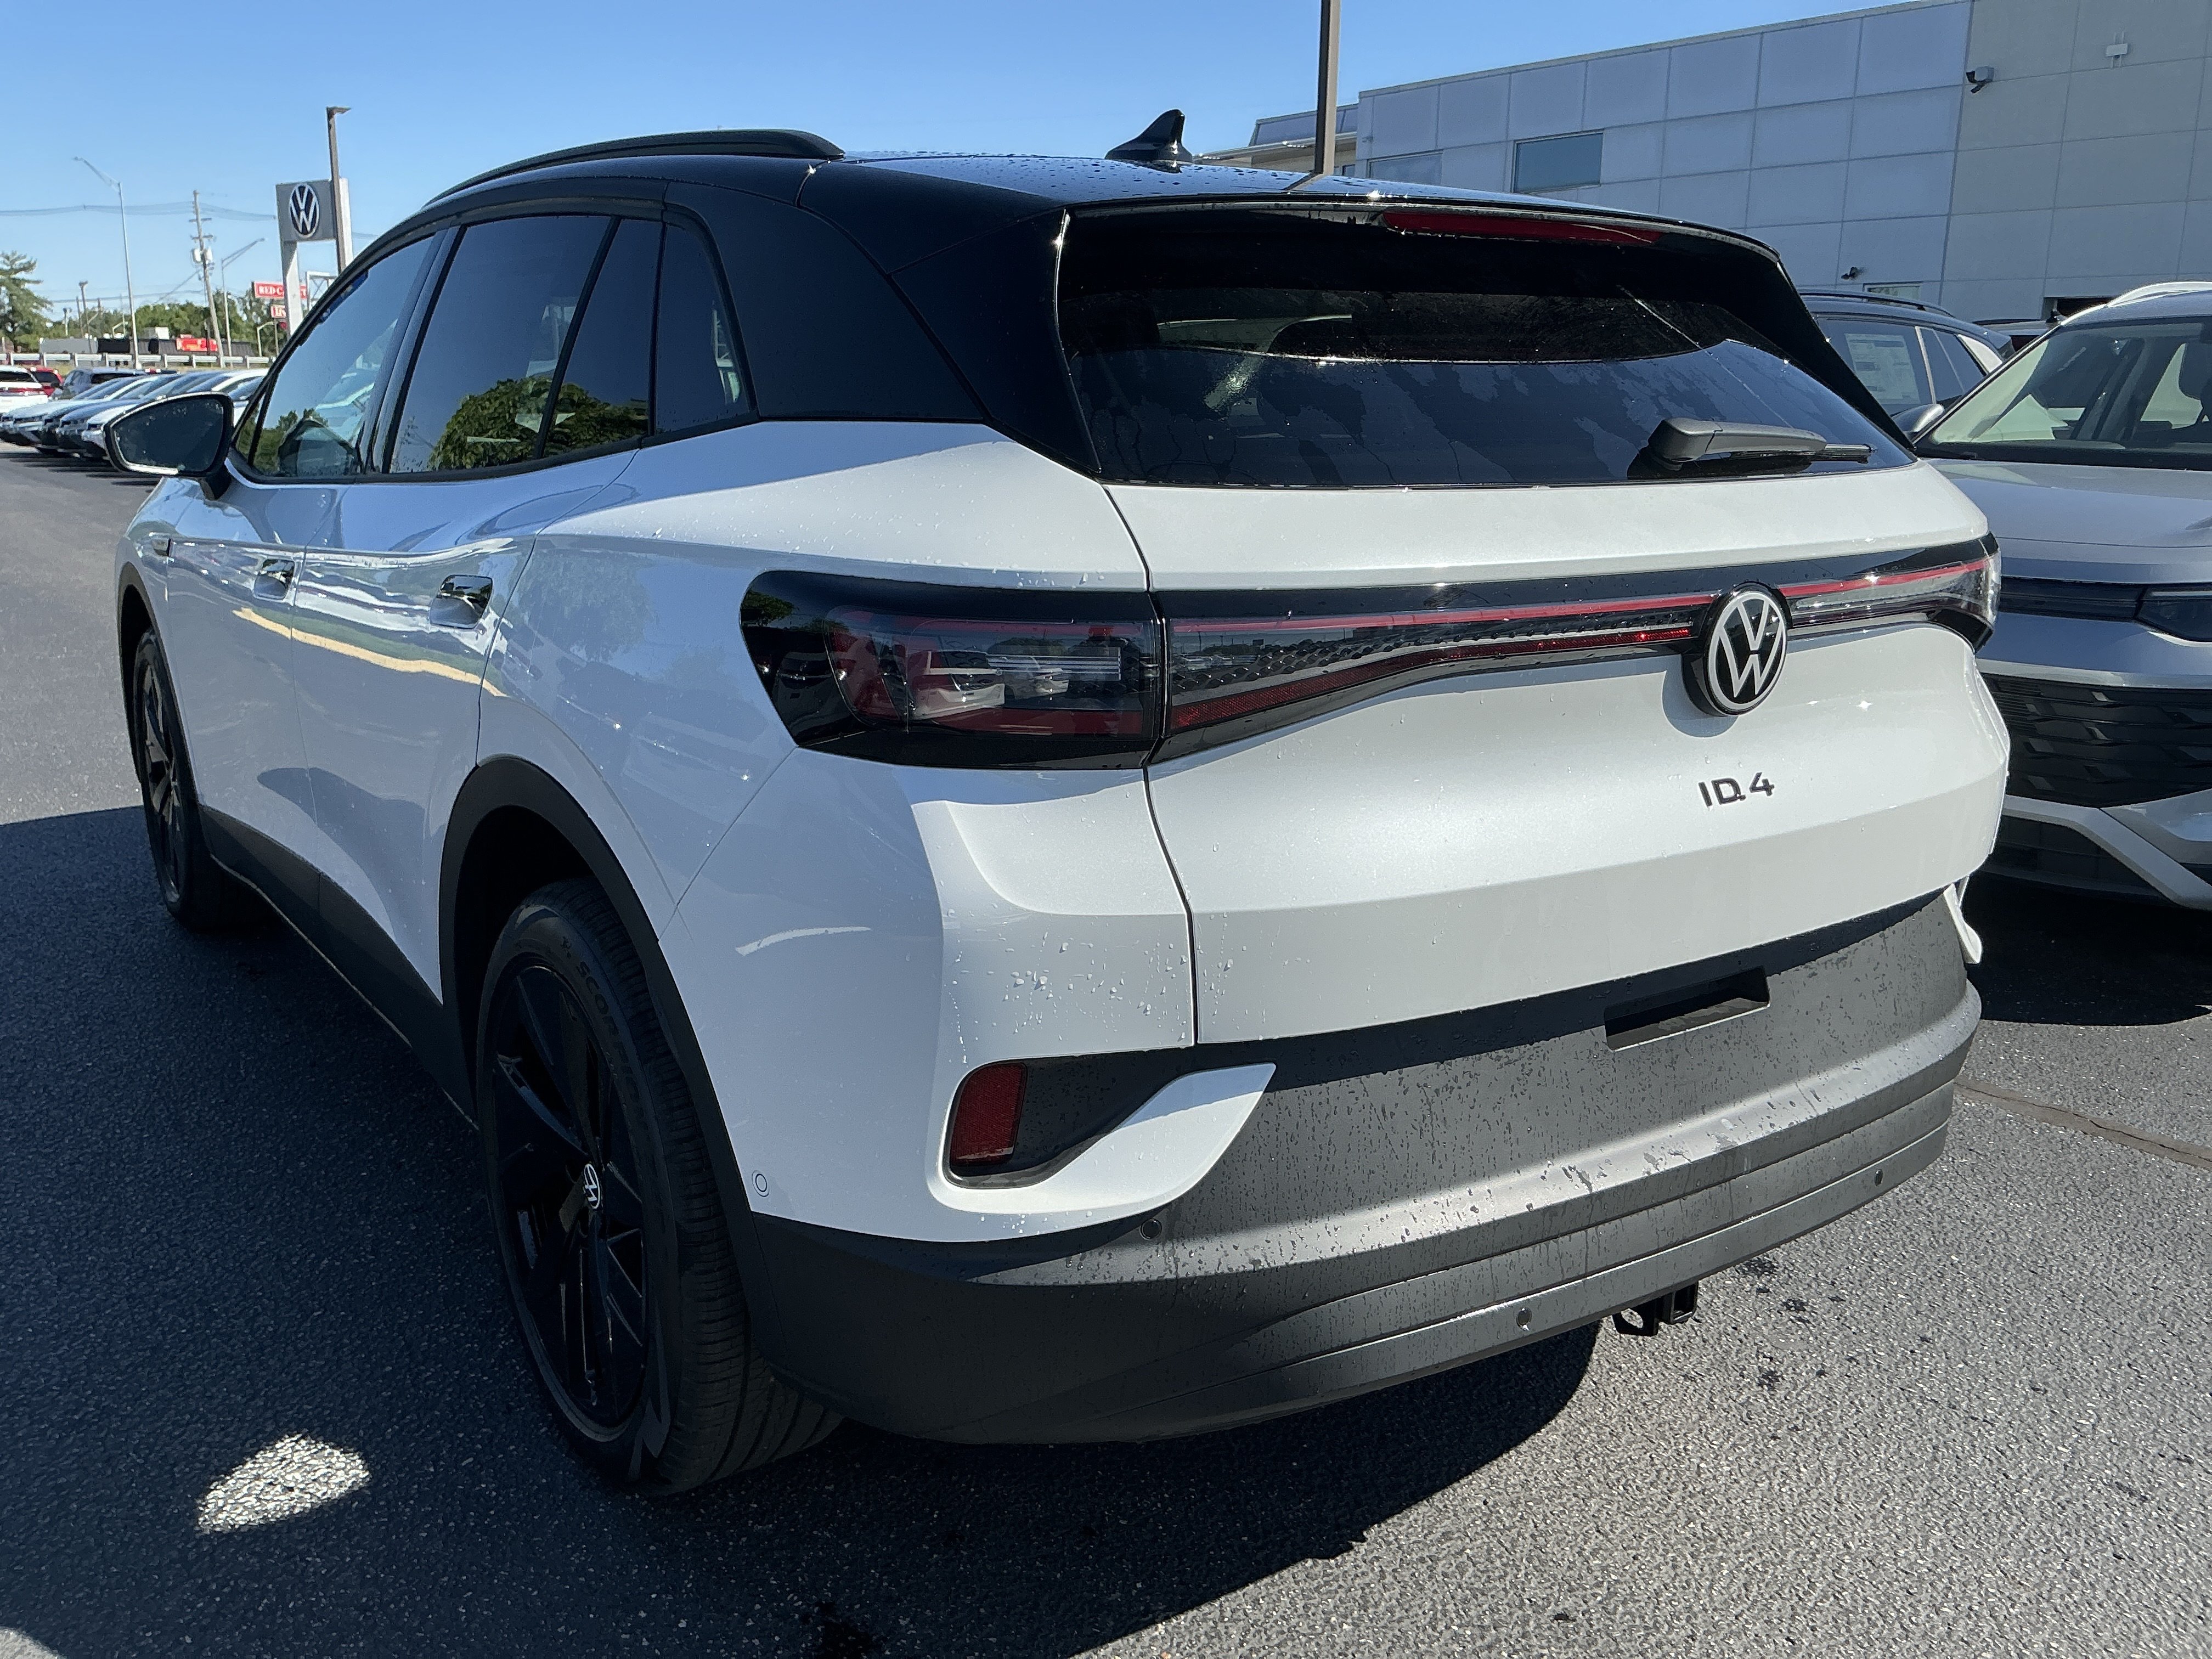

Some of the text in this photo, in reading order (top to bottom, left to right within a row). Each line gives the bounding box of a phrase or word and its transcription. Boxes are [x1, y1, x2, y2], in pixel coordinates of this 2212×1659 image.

[289, 184, 319, 238] VW
[258, 285, 276, 295] RED
[1707, 590, 1787, 712] VW
